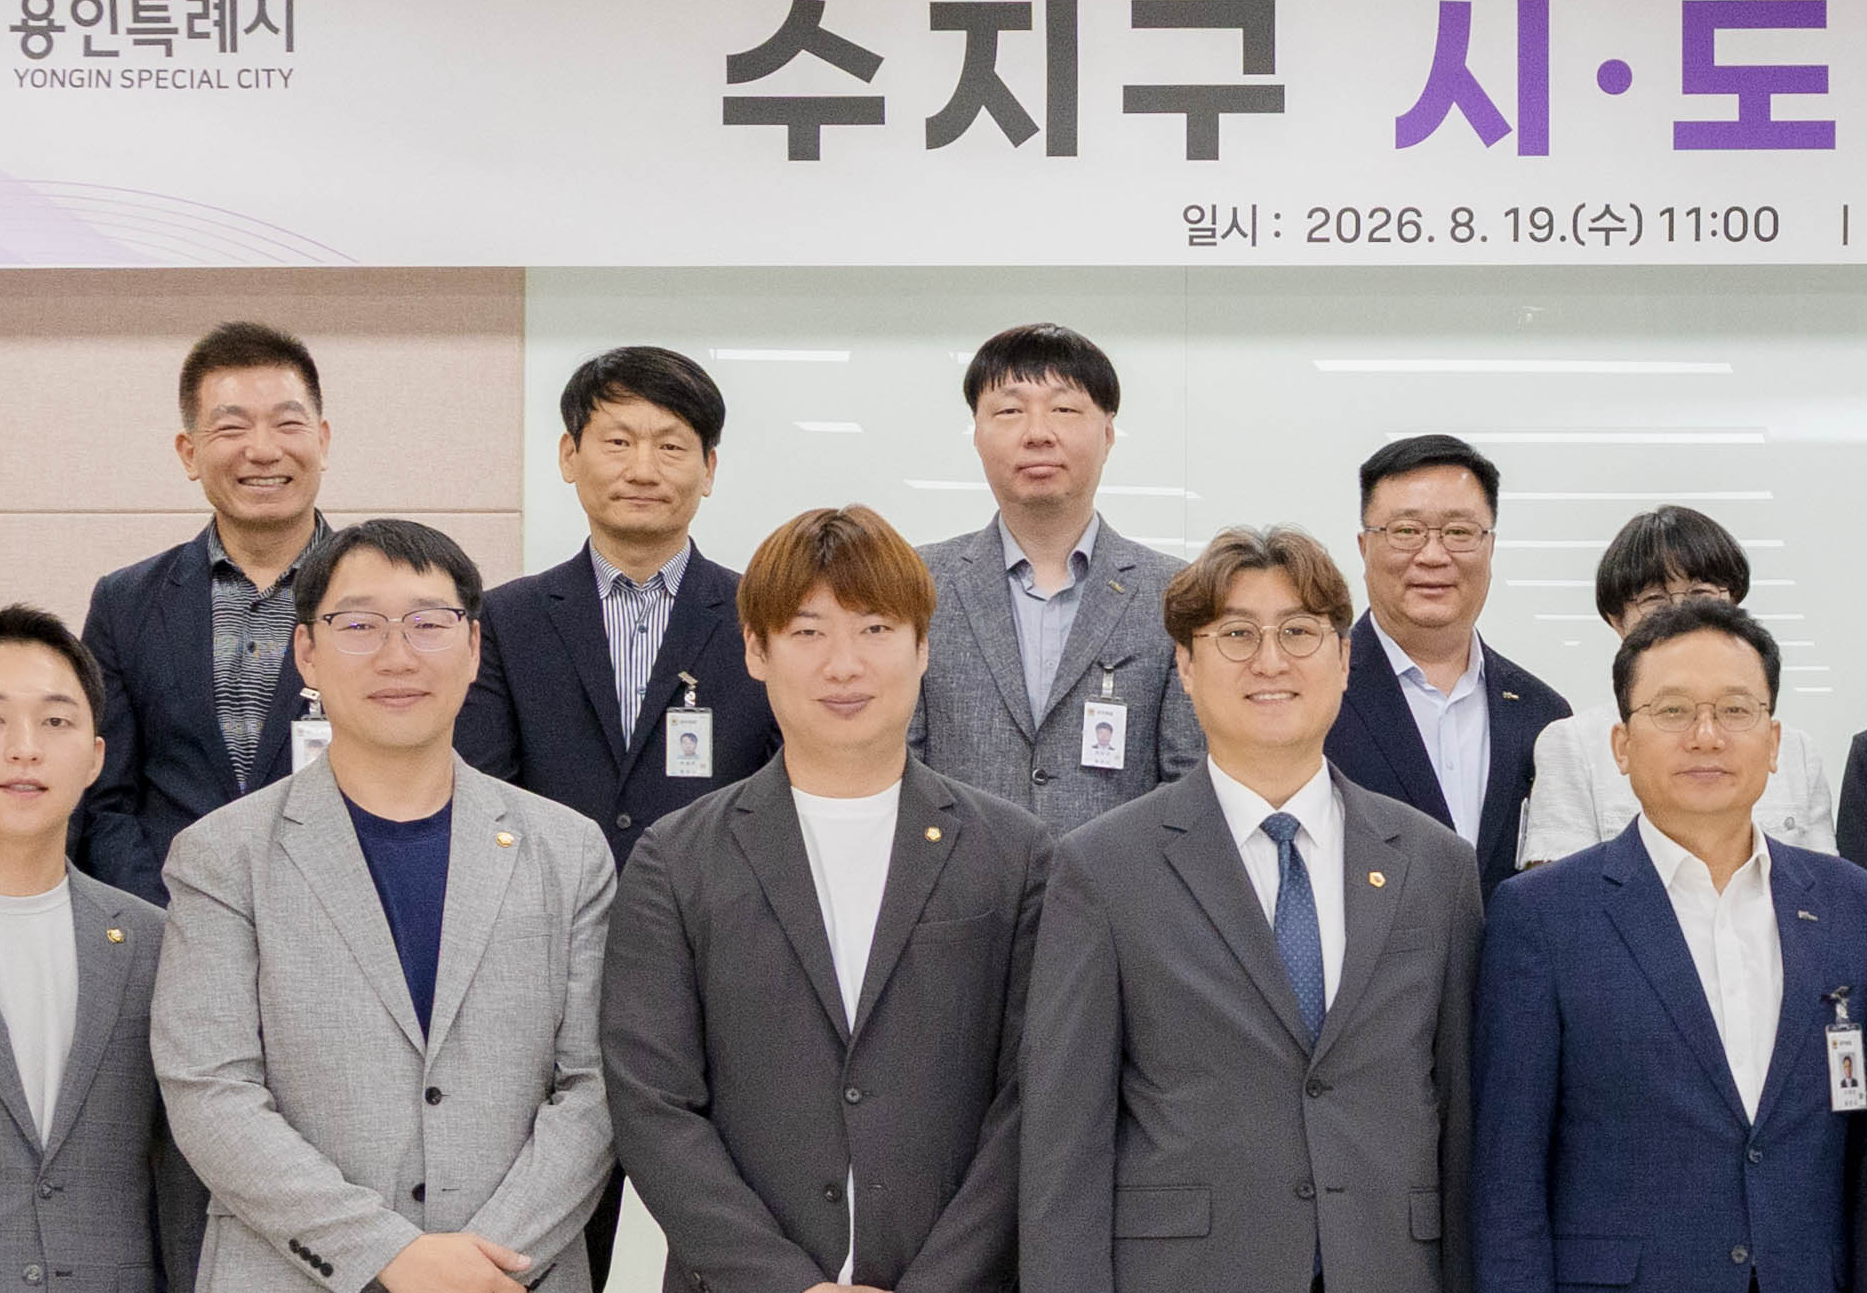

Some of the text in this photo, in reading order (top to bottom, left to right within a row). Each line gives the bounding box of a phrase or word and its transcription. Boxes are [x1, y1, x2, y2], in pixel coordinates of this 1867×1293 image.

[13, 68, 295, 91] YONGIN SPECIAL CITY
[1306, 206, 1436, 245] 2026.
[1449, 207, 1489, 245] 8.
[1659, 206, 1781, 244] 11:00
